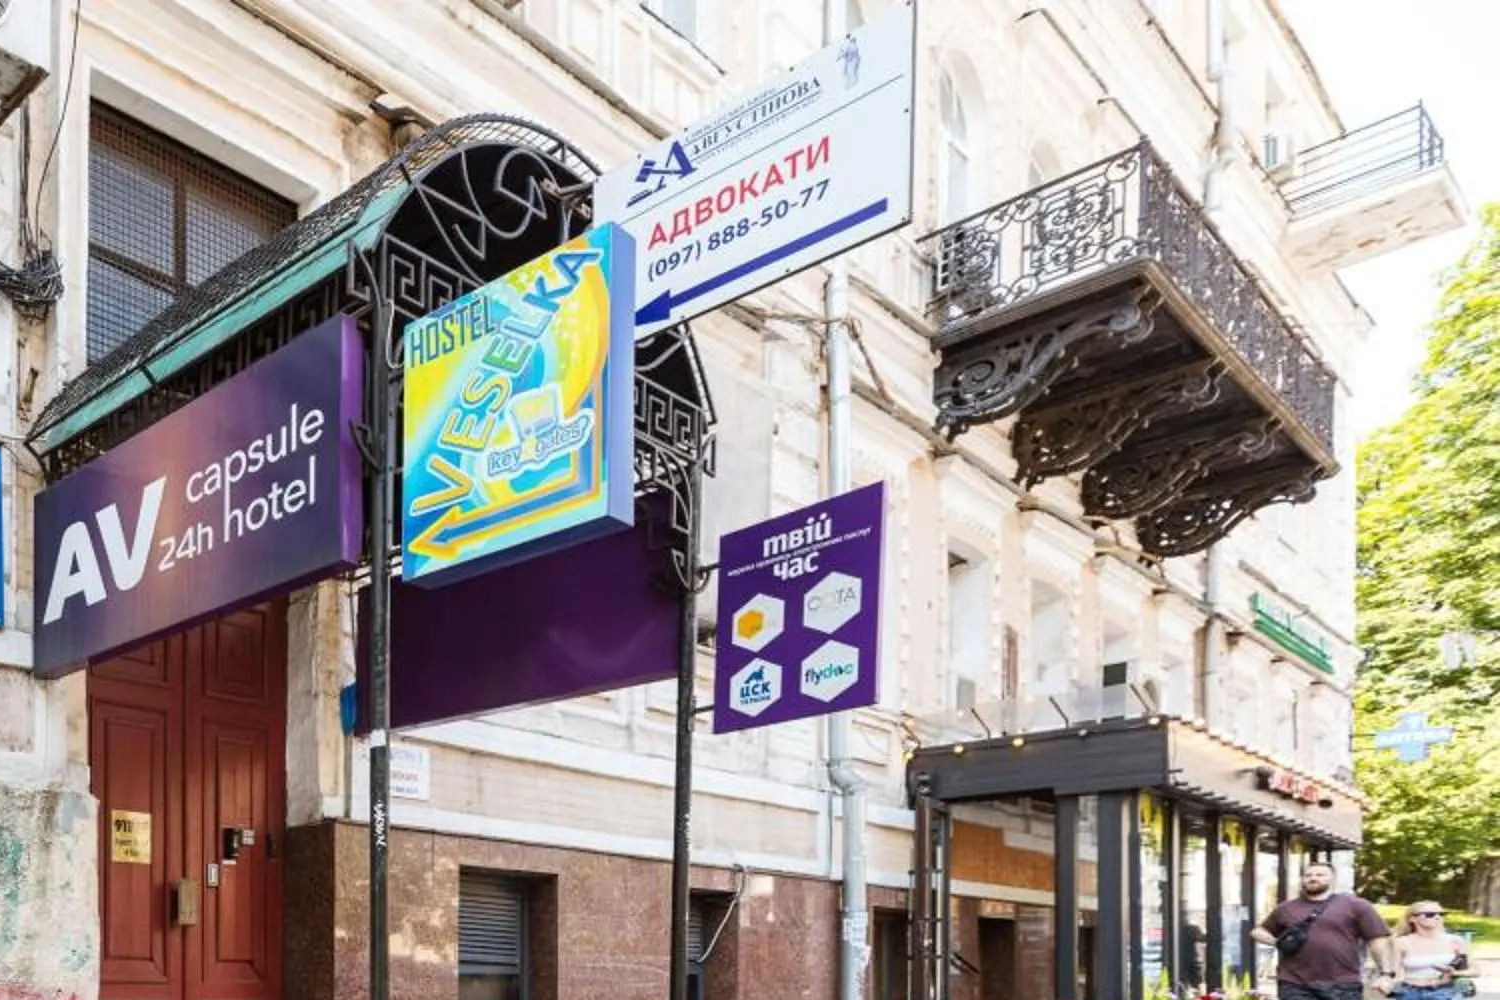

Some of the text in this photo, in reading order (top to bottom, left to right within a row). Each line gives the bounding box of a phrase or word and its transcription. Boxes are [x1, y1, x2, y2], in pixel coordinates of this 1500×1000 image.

[647, 179, 830, 282] (097) 888-50-77
[648, 136, 831, 250] АДВОКАТИ
[410, 295, 496, 368] HOSTEL
[410, 249, 602, 515] VESELKA
[185, 403, 325, 505] capsule
[42, 476, 166, 625] AV
[158, 455, 316, 572] 24h hotel
[773, 551, 820, 580] час
[805, 664, 853, 685] flydoc
